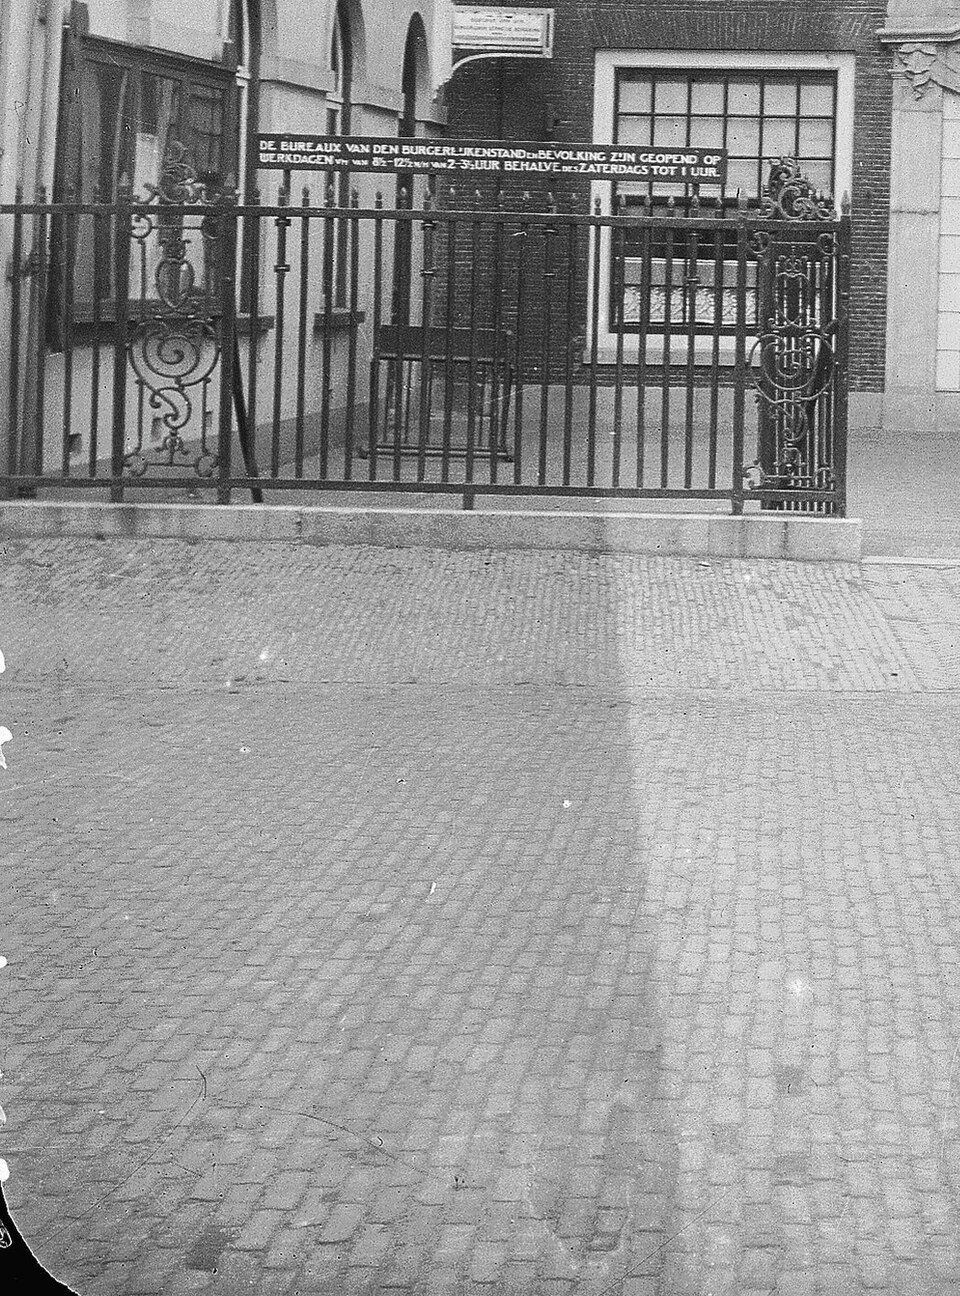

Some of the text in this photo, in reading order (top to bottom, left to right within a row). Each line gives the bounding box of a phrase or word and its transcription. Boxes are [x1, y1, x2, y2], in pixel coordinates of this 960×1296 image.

[259, 140, 277, 151] DE
[280, 141, 342, 153] BUREAUX
[345, 143, 370, 153] VAN
[372, 144, 399, 154] DEN
[538, 150, 606, 161] BEVOLKING
[609, 152, 636, 162] ZIJN
[640, 153, 698, 164] GEOPEND
[703, 155, 722, 165] OP
[259, 153, 334, 165] WERKDAGEN
[504, 161, 561, 172] BEHALVE
[579, 163, 649, 175] ZATERDAGS
[651, 166, 678, 176] TOT
